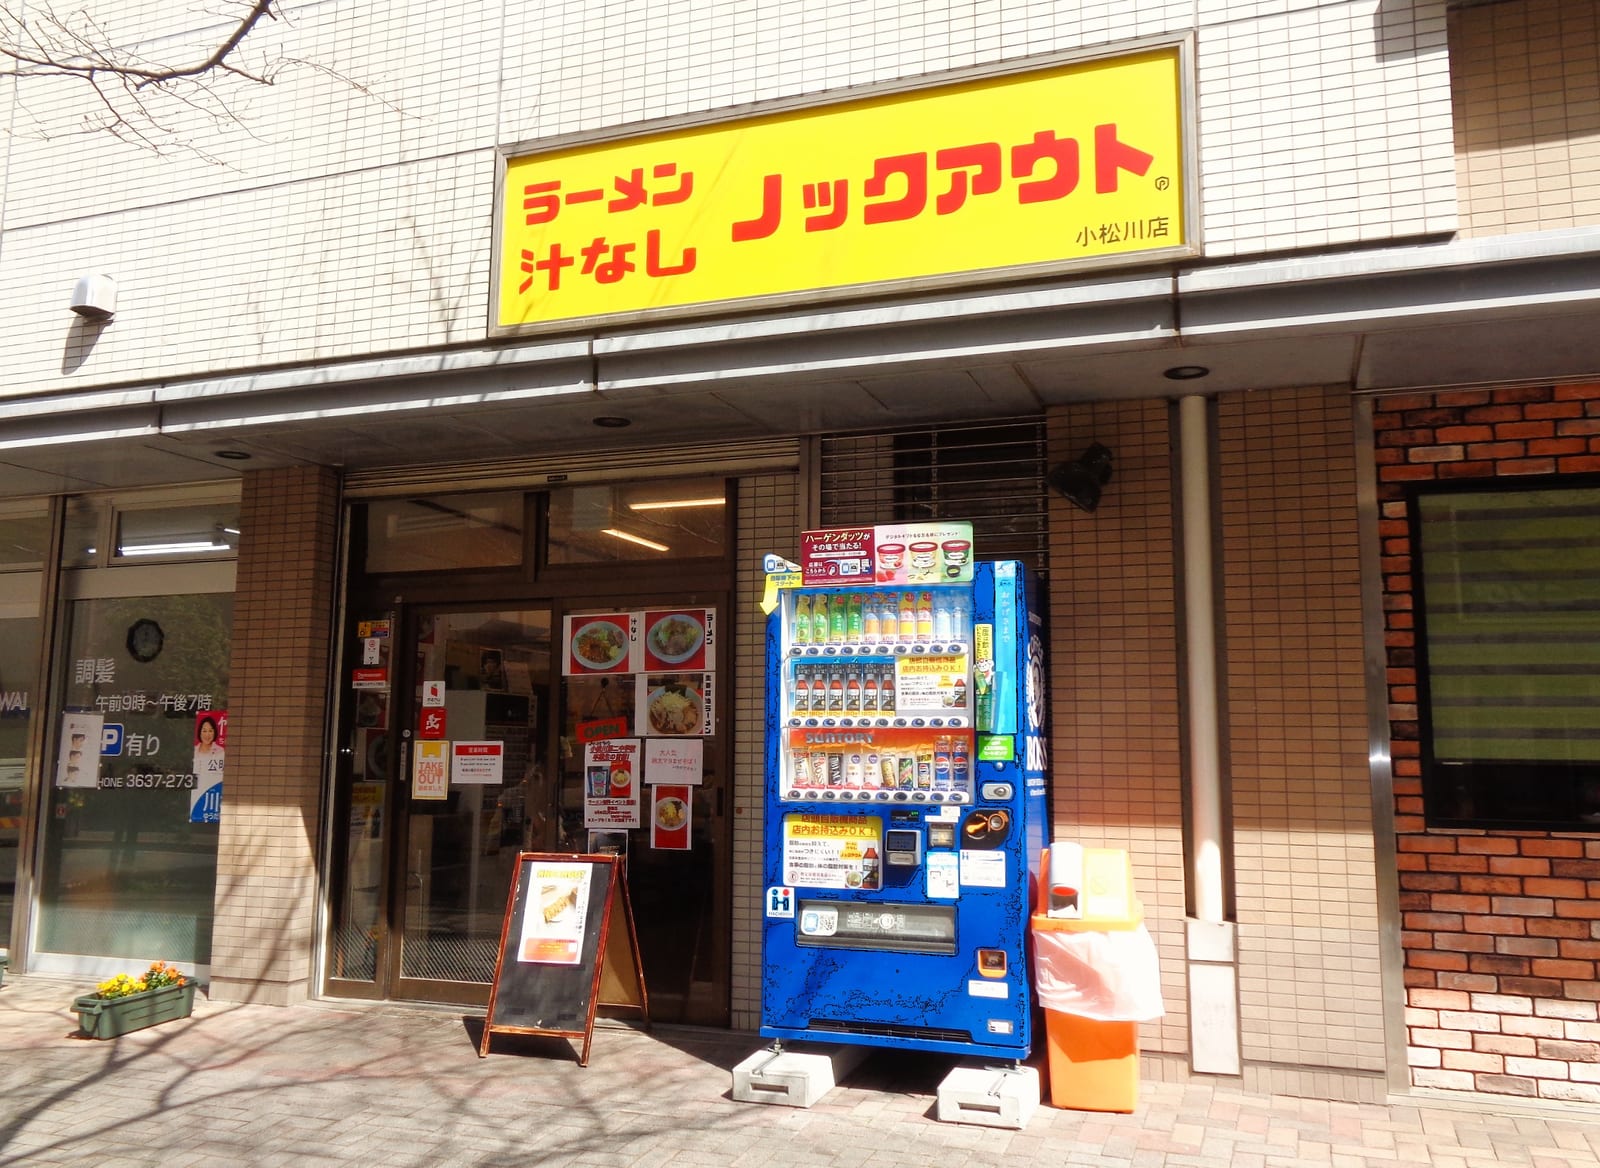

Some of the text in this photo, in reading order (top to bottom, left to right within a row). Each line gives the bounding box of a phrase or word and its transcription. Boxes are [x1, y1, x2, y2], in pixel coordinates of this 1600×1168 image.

[523, 162, 694, 227] ラーメン
[731, 122, 1155, 243] ノックアウト
[1075, 216, 1169, 247] 小松川店
[518, 228, 697, 295] 汁なし
[805, 531, 871, 544] ハーゲンダッツが
[706, 613, 714, 645] ラーメン
[75, 658, 115, 685] 調髪
[584, 724, 620, 739] OPEN
[805, 731, 874, 744] SUNTORY
[126, 734, 160, 757] 有り
[1026, 735, 1048, 771] BOSS
[418, 761, 444, 772] TAKE
[418, 773, 443, 785] OUT
[97, 776, 123, 788] HONE
